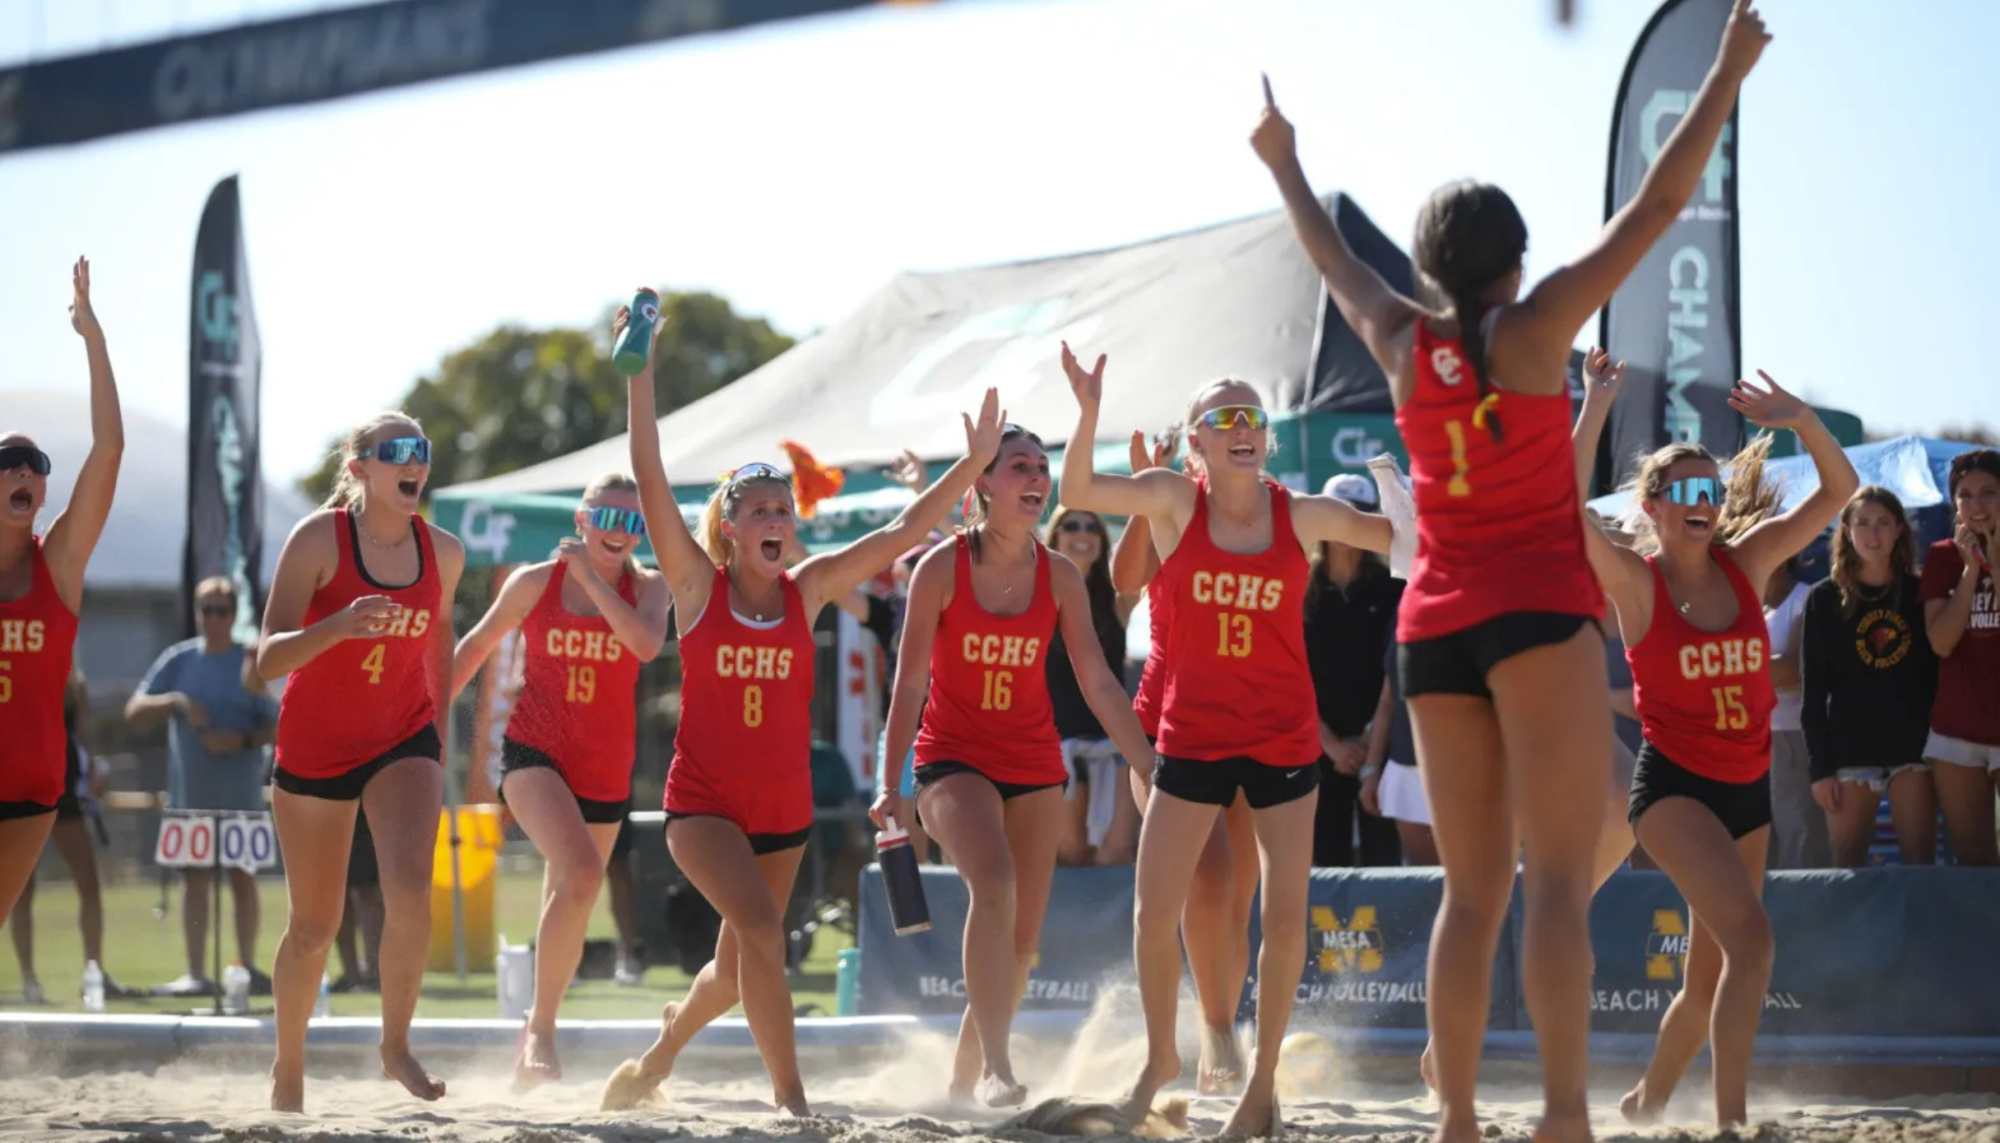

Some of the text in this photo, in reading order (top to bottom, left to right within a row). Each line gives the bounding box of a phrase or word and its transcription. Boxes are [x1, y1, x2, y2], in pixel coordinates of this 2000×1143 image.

[1445, 420, 1471, 496] 1
[1193, 571, 1284, 610] CCHS
[0, 619, 45, 653] HS
[367, 608, 431, 638] HS
[1217, 612, 1253, 658] 13
[361, 644, 386, 684] 4
[547, 628, 623, 662] CCHS
[716, 644, 794, 680] CCHS
[962, 632, 1041, 666] CCHS
[1679, 637, 1764, 680] CCHS
[565, 666, 596, 704] 19
[981, 670, 1013, 711] 16
[743, 685, 763, 728] 8
[1711, 685, 1749, 731] 15
[161, 823, 271, 861] 00 00
[1322, 930, 1371, 949] MESA
[1660, 935, 1689, 954] ME
[919, 976, 1093, 1001] BEAC EYBALL
